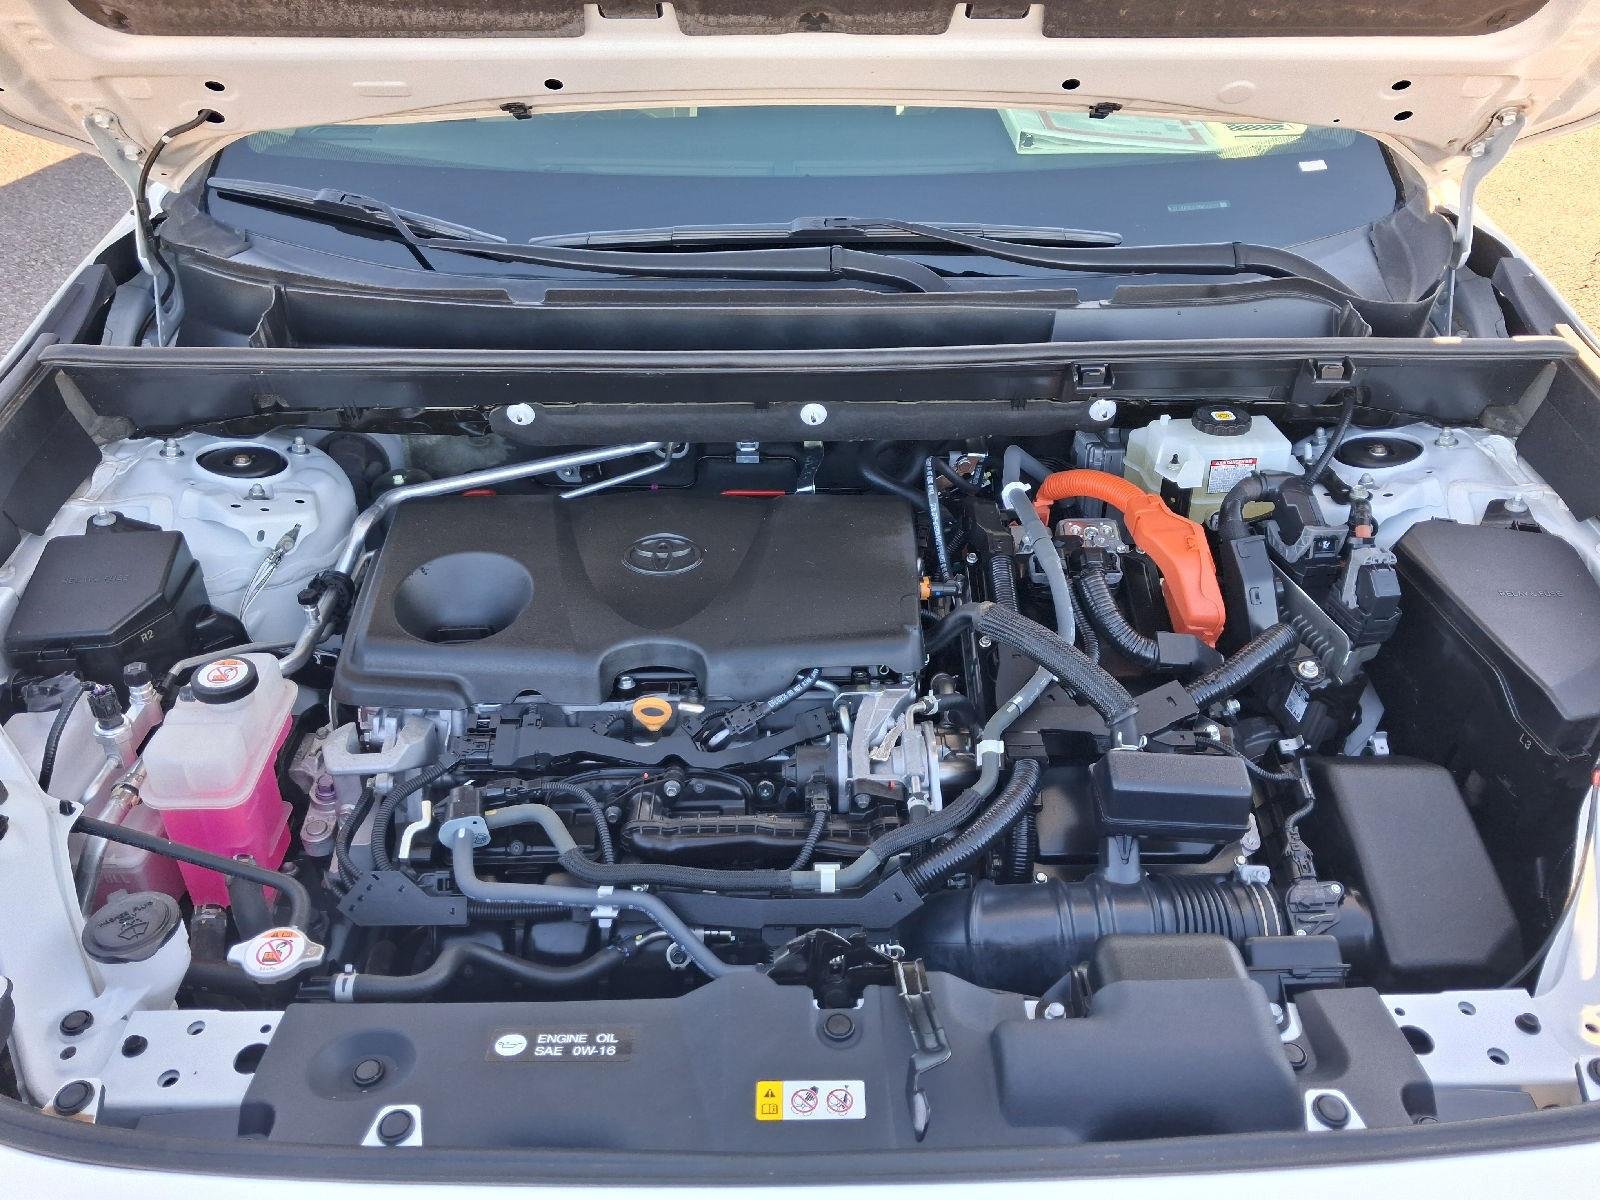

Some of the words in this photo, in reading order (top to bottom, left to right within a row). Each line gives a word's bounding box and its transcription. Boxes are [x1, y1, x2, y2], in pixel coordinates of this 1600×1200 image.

[1497, 590, 1528, 598] RELAY
[1538, 590, 1564, 598] FUSE
[140, 629, 155, 643] R2
[1519, 732, 1532, 750] L3
[97, 911, 129, 928] WASHER
[132, 901, 153, 913] FLUID
[537, 1033, 588, 1044] ENGINE
[595, 1033, 620, 1044] OIL
[534, 1045, 564, 1056] SAE
[572, 1045, 617, 1056] 0W-16
